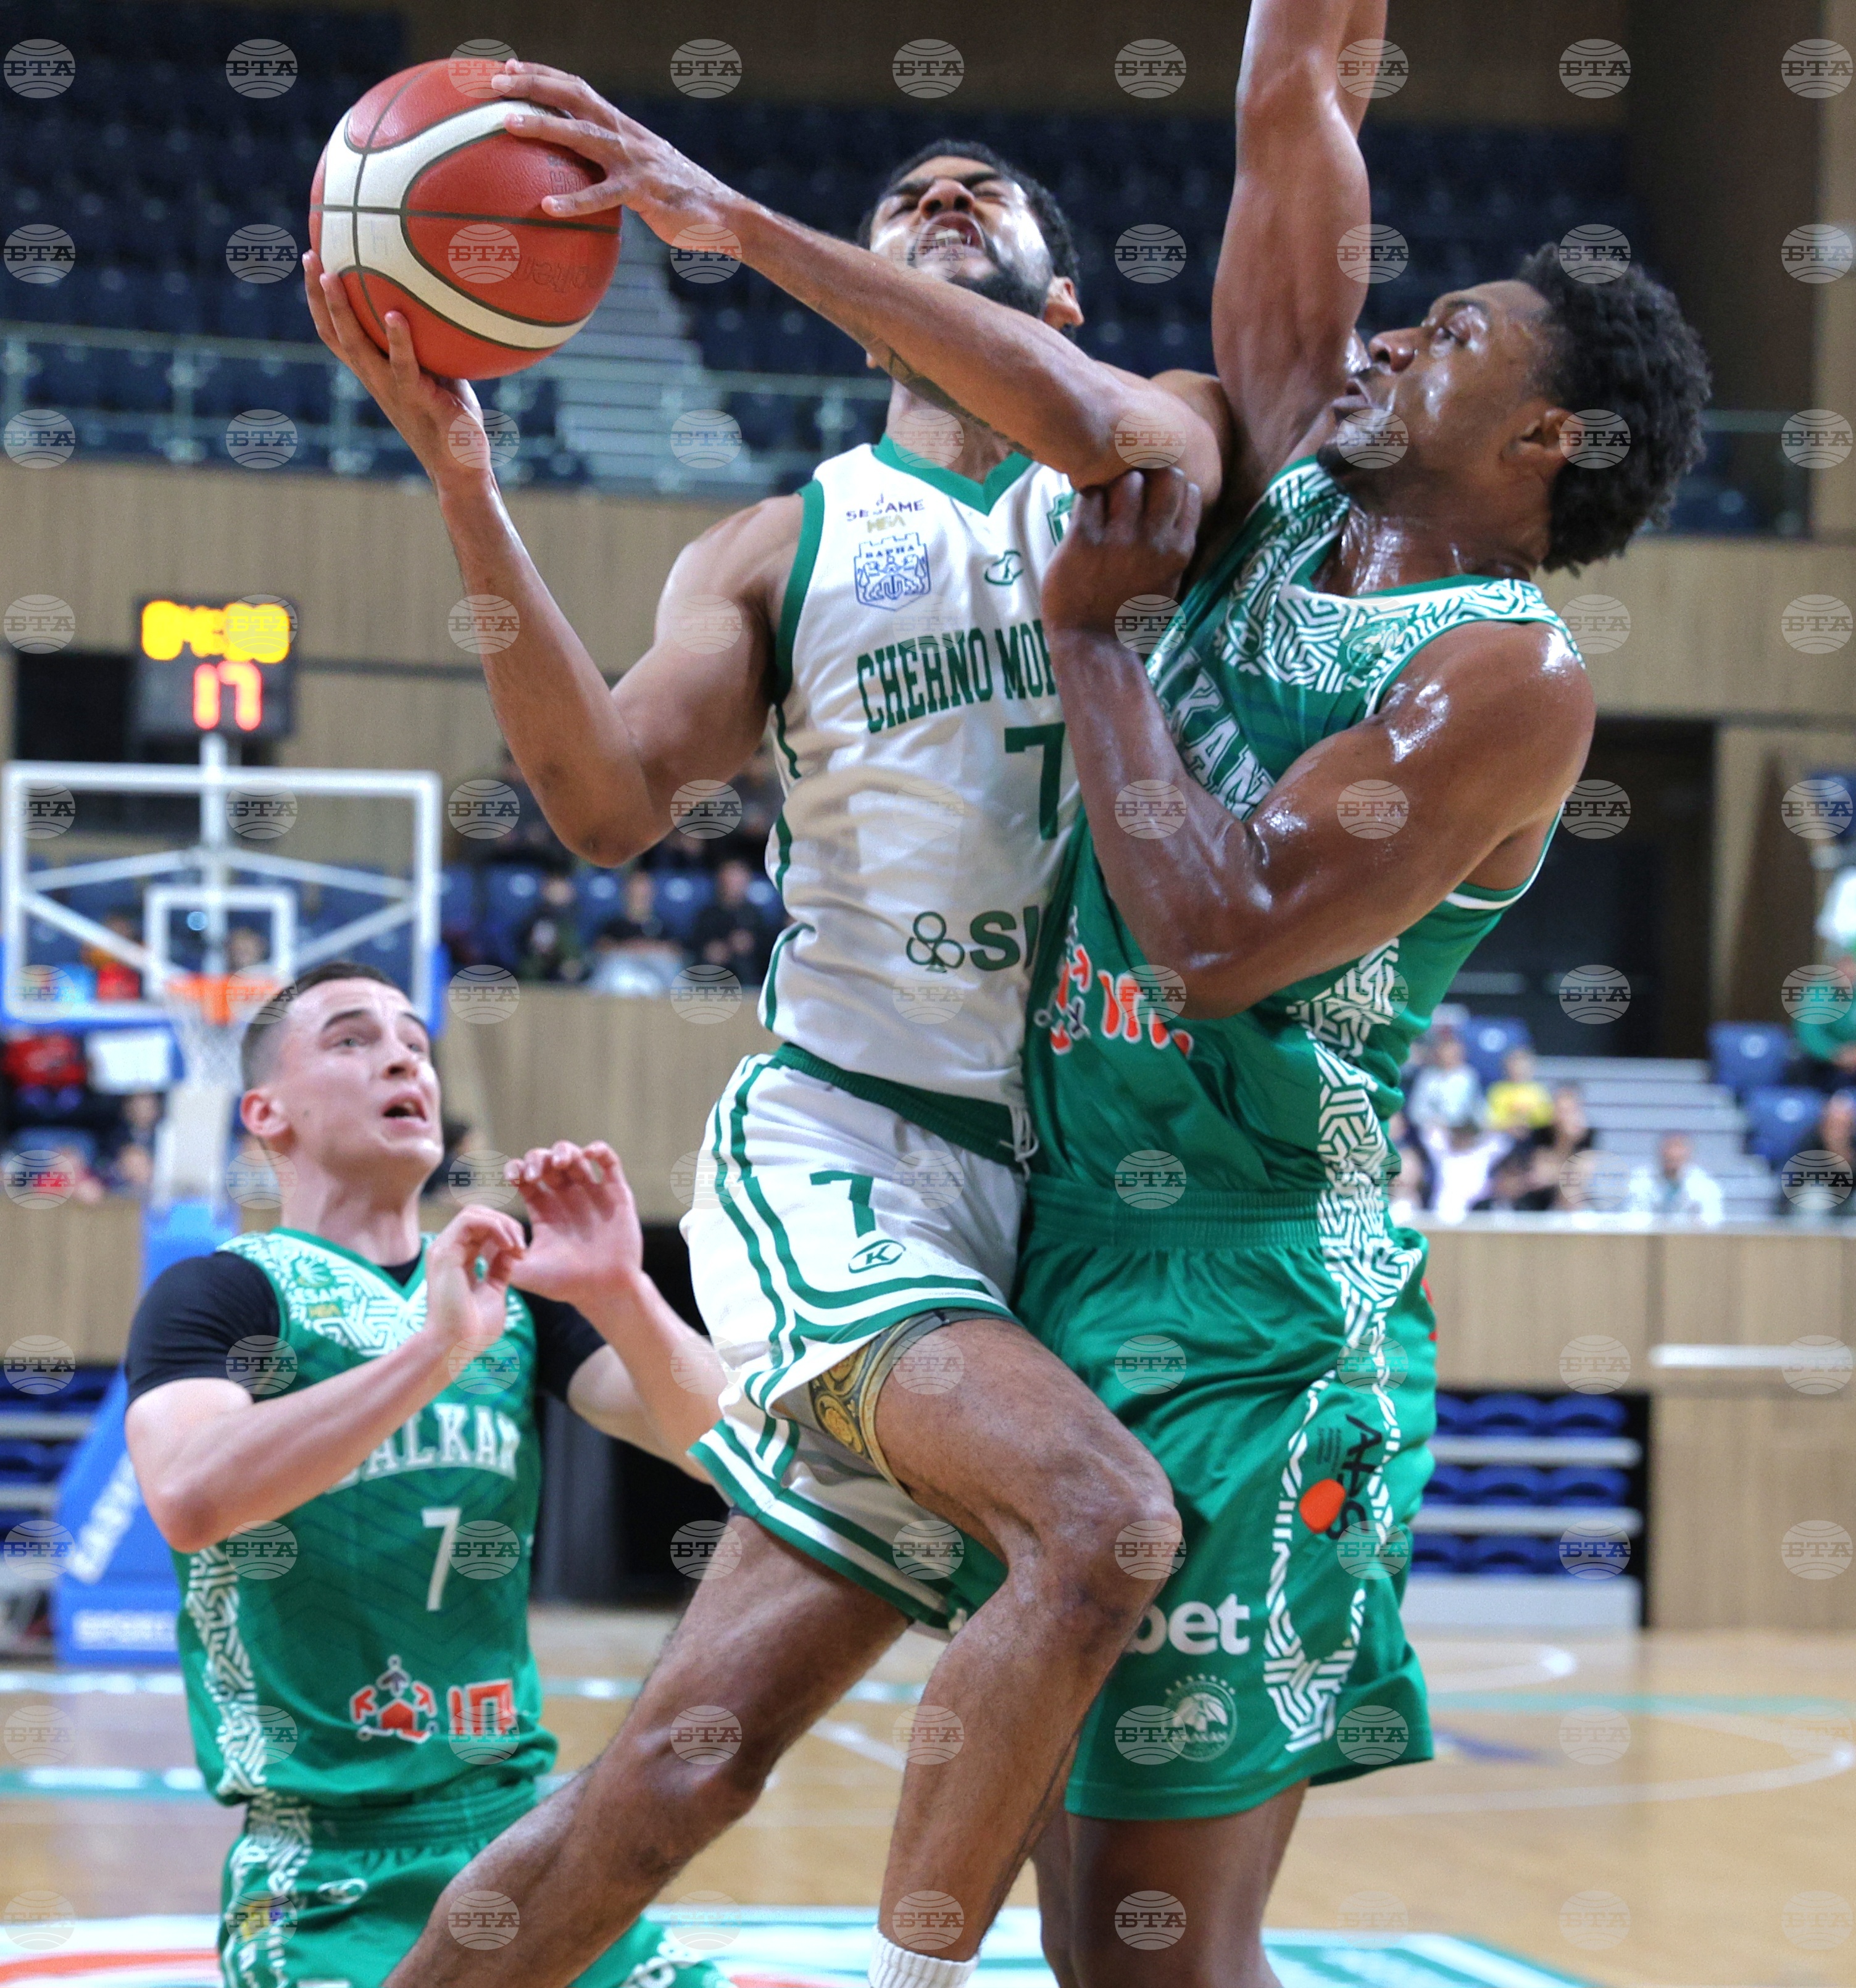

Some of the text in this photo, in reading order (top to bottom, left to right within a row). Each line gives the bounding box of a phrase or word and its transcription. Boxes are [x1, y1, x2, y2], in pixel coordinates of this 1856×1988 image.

[193, 659, 263, 732] 17
[857, 627, 993, 734] CHERNO
[1004, 722, 1065, 841] 7
[810, 1170, 876, 1239] 7
[421, 1506, 462, 1612] 7
